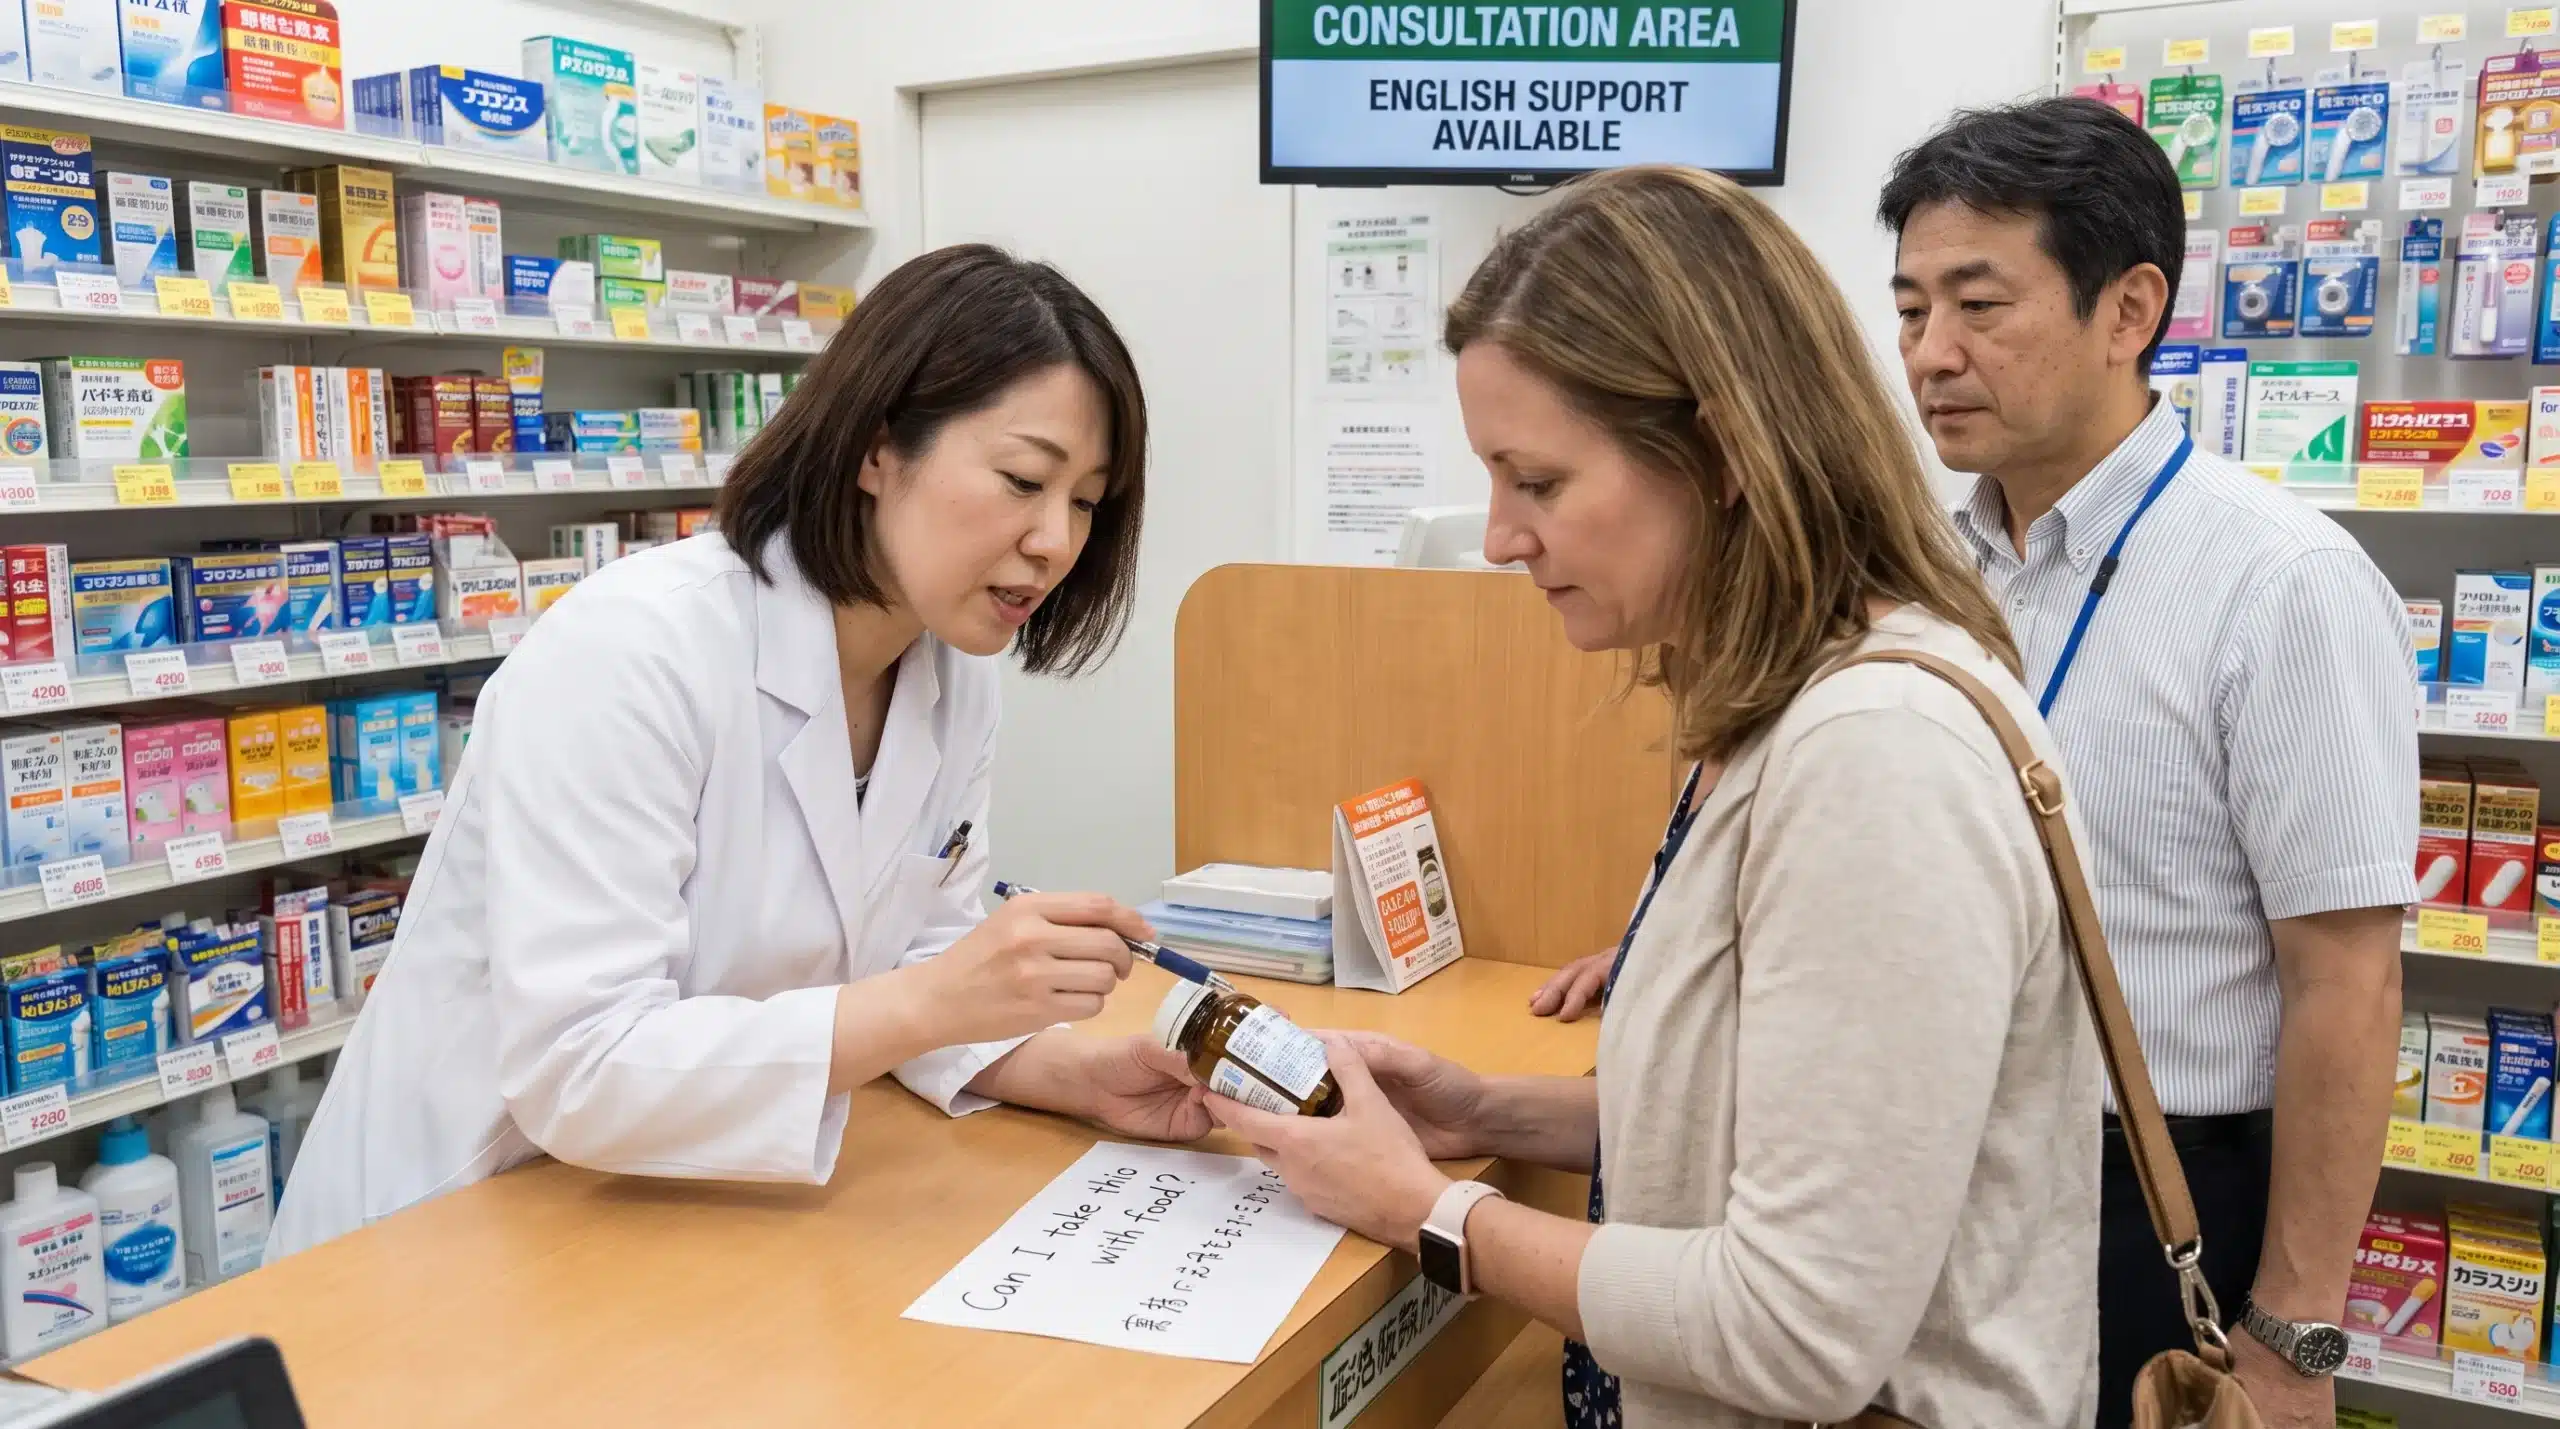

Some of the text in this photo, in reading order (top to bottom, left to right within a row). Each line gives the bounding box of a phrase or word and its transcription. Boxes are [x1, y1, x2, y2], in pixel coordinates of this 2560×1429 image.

[1313, 5, 1739, 48] CONSULTATION AREA
[1370, 79, 1689, 113] ENGLISH SUPPORT
[1432, 120, 1621, 152] AVAILABLE
[31, 685, 66, 700] 4200
[155, 671, 185, 686] 4200
[1092, 1172, 1197, 1266] with food?
[962, 1270, 1031, 1311] Can
[1012, 1244, 1056, 1262] I
[1043, 1203, 1102, 1243] take
